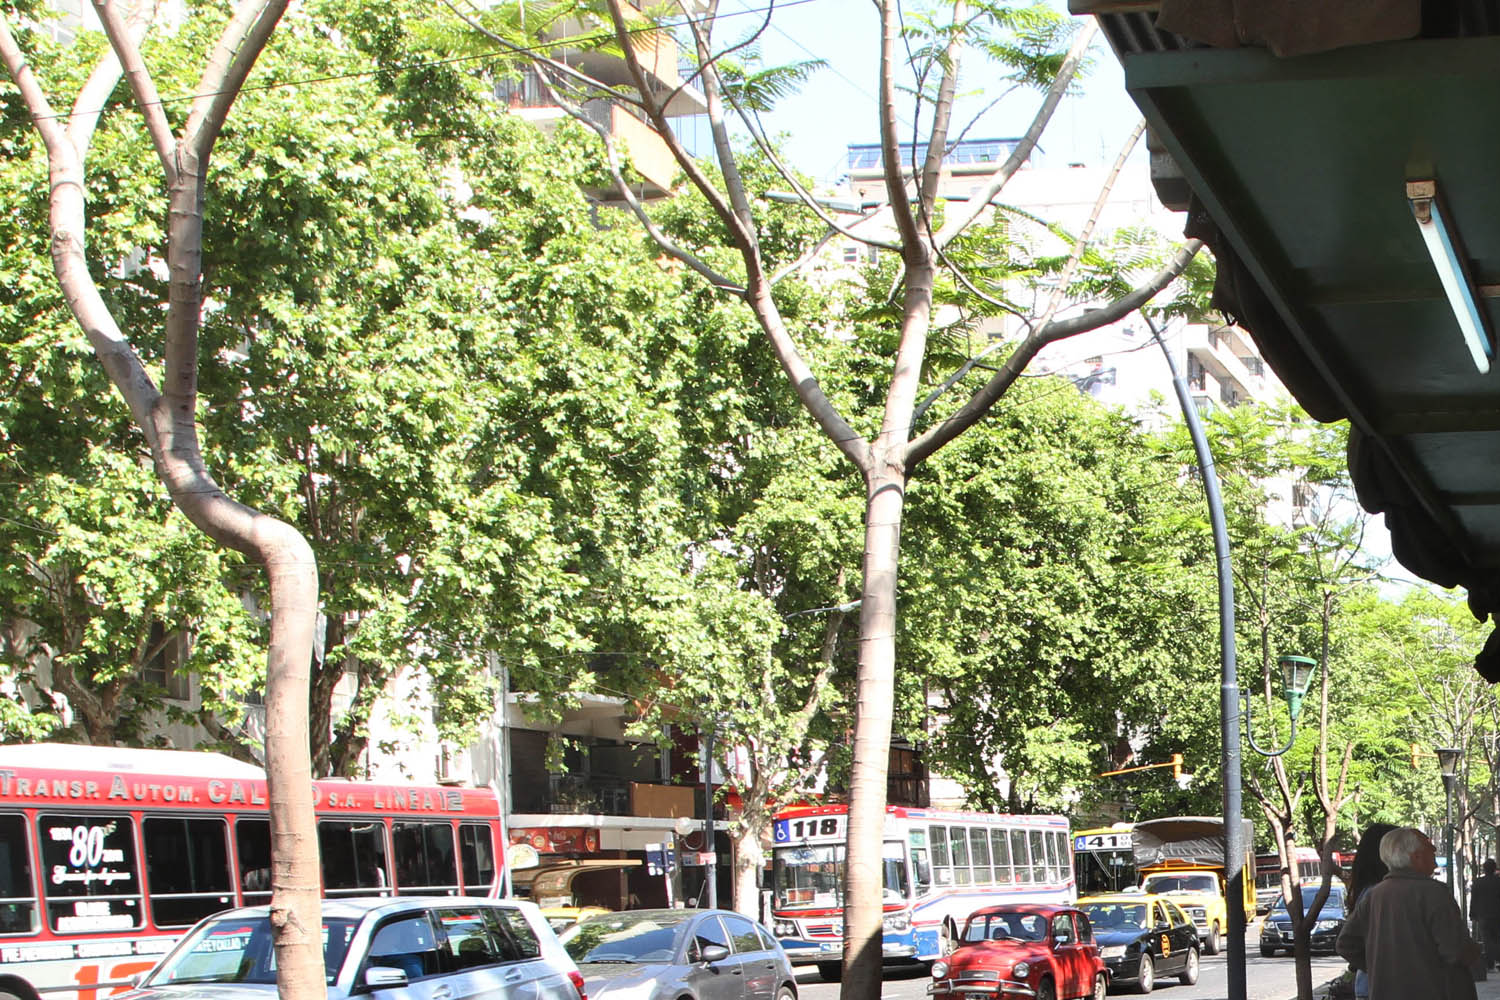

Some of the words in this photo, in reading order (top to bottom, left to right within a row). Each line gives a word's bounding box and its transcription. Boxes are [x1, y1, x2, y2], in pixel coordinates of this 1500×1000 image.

[108, 775, 200, 803] AUTOM.
[793, 818, 839, 838] 118
[69, 825, 105, 868] 80
[1088, 836, 1118, 848] 41
